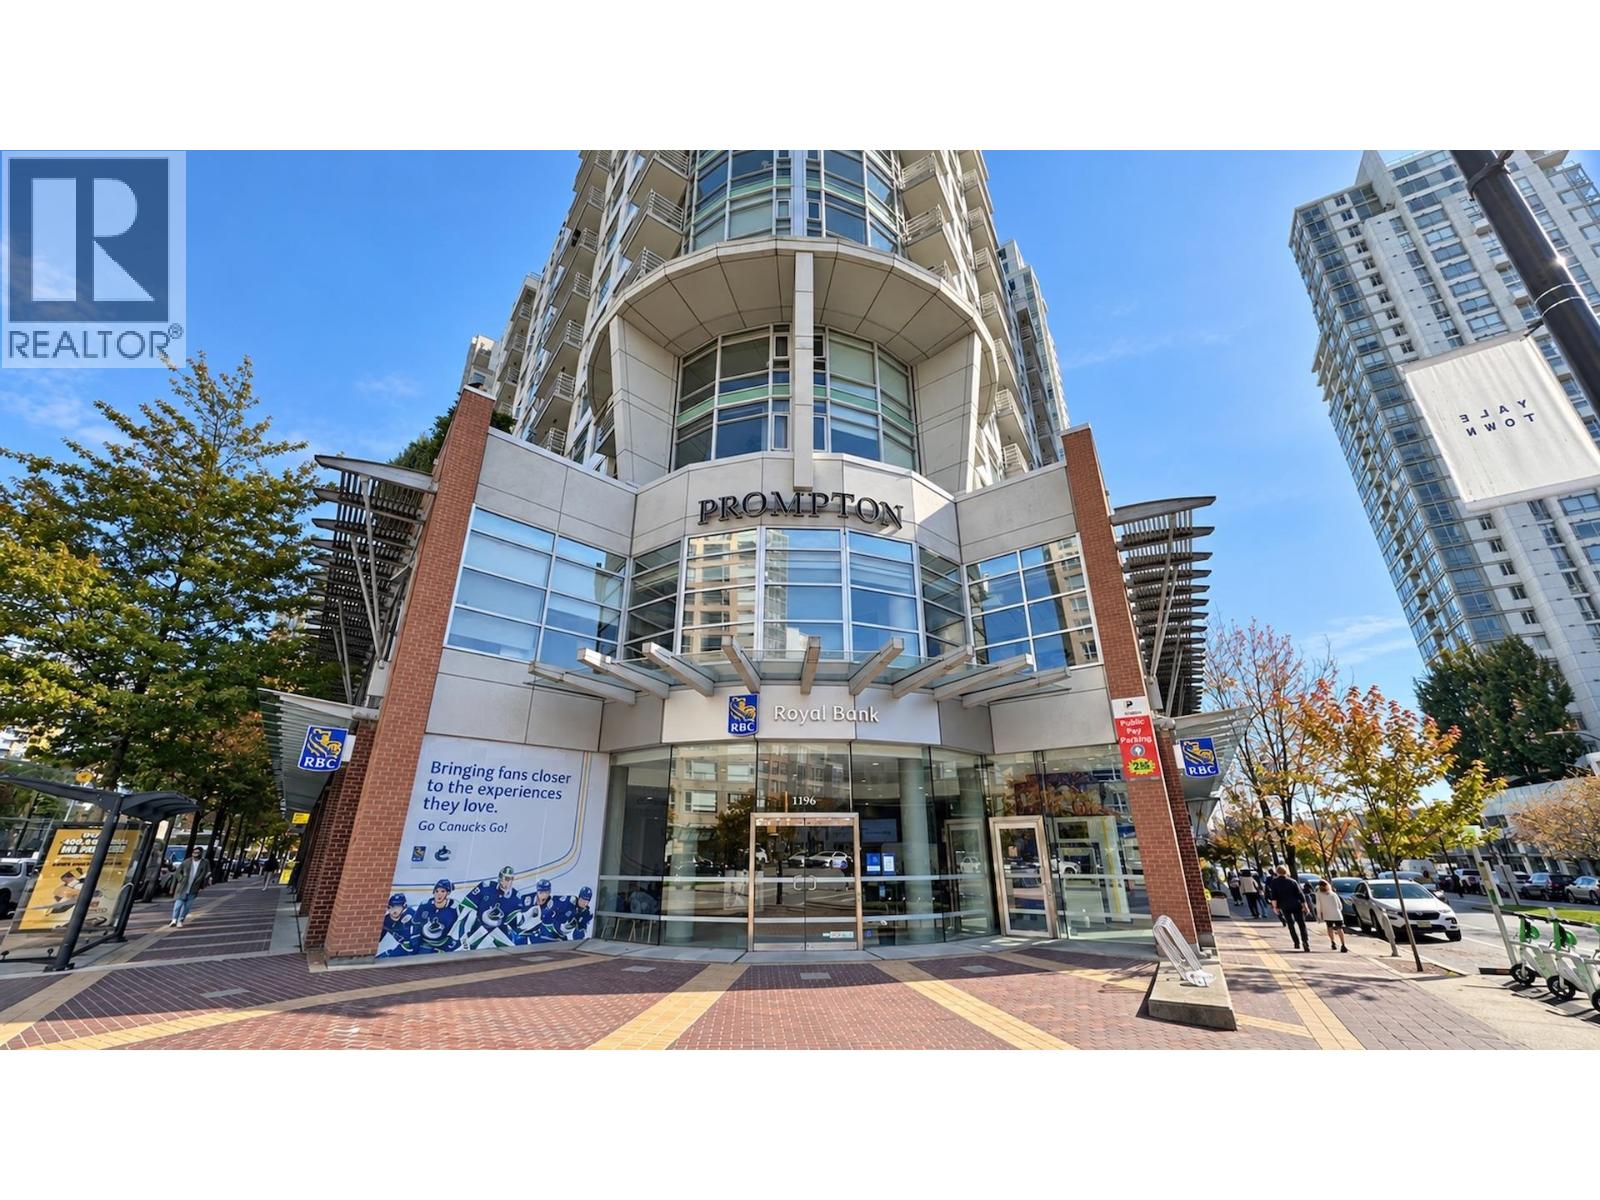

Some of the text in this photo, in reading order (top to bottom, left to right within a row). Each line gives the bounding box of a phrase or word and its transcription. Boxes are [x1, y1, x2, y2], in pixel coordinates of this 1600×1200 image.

[698, 491, 904, 530] PROMPTON
[773, 704, 879, 726] Royal Bank
[730, 722, 755, 733] RBC
[304, 757, 337, 768] RBC
[1190, 765, 1217, 775] RBC
[430, 760, 572, 784] Bringing fans closer
[427, 779, 562, 800] to the experiences
[423, 797, 498, 815] they love.
[793, 796, 816, 806] 1196
[418, 820, 508, 833] Go Canucks Go!
